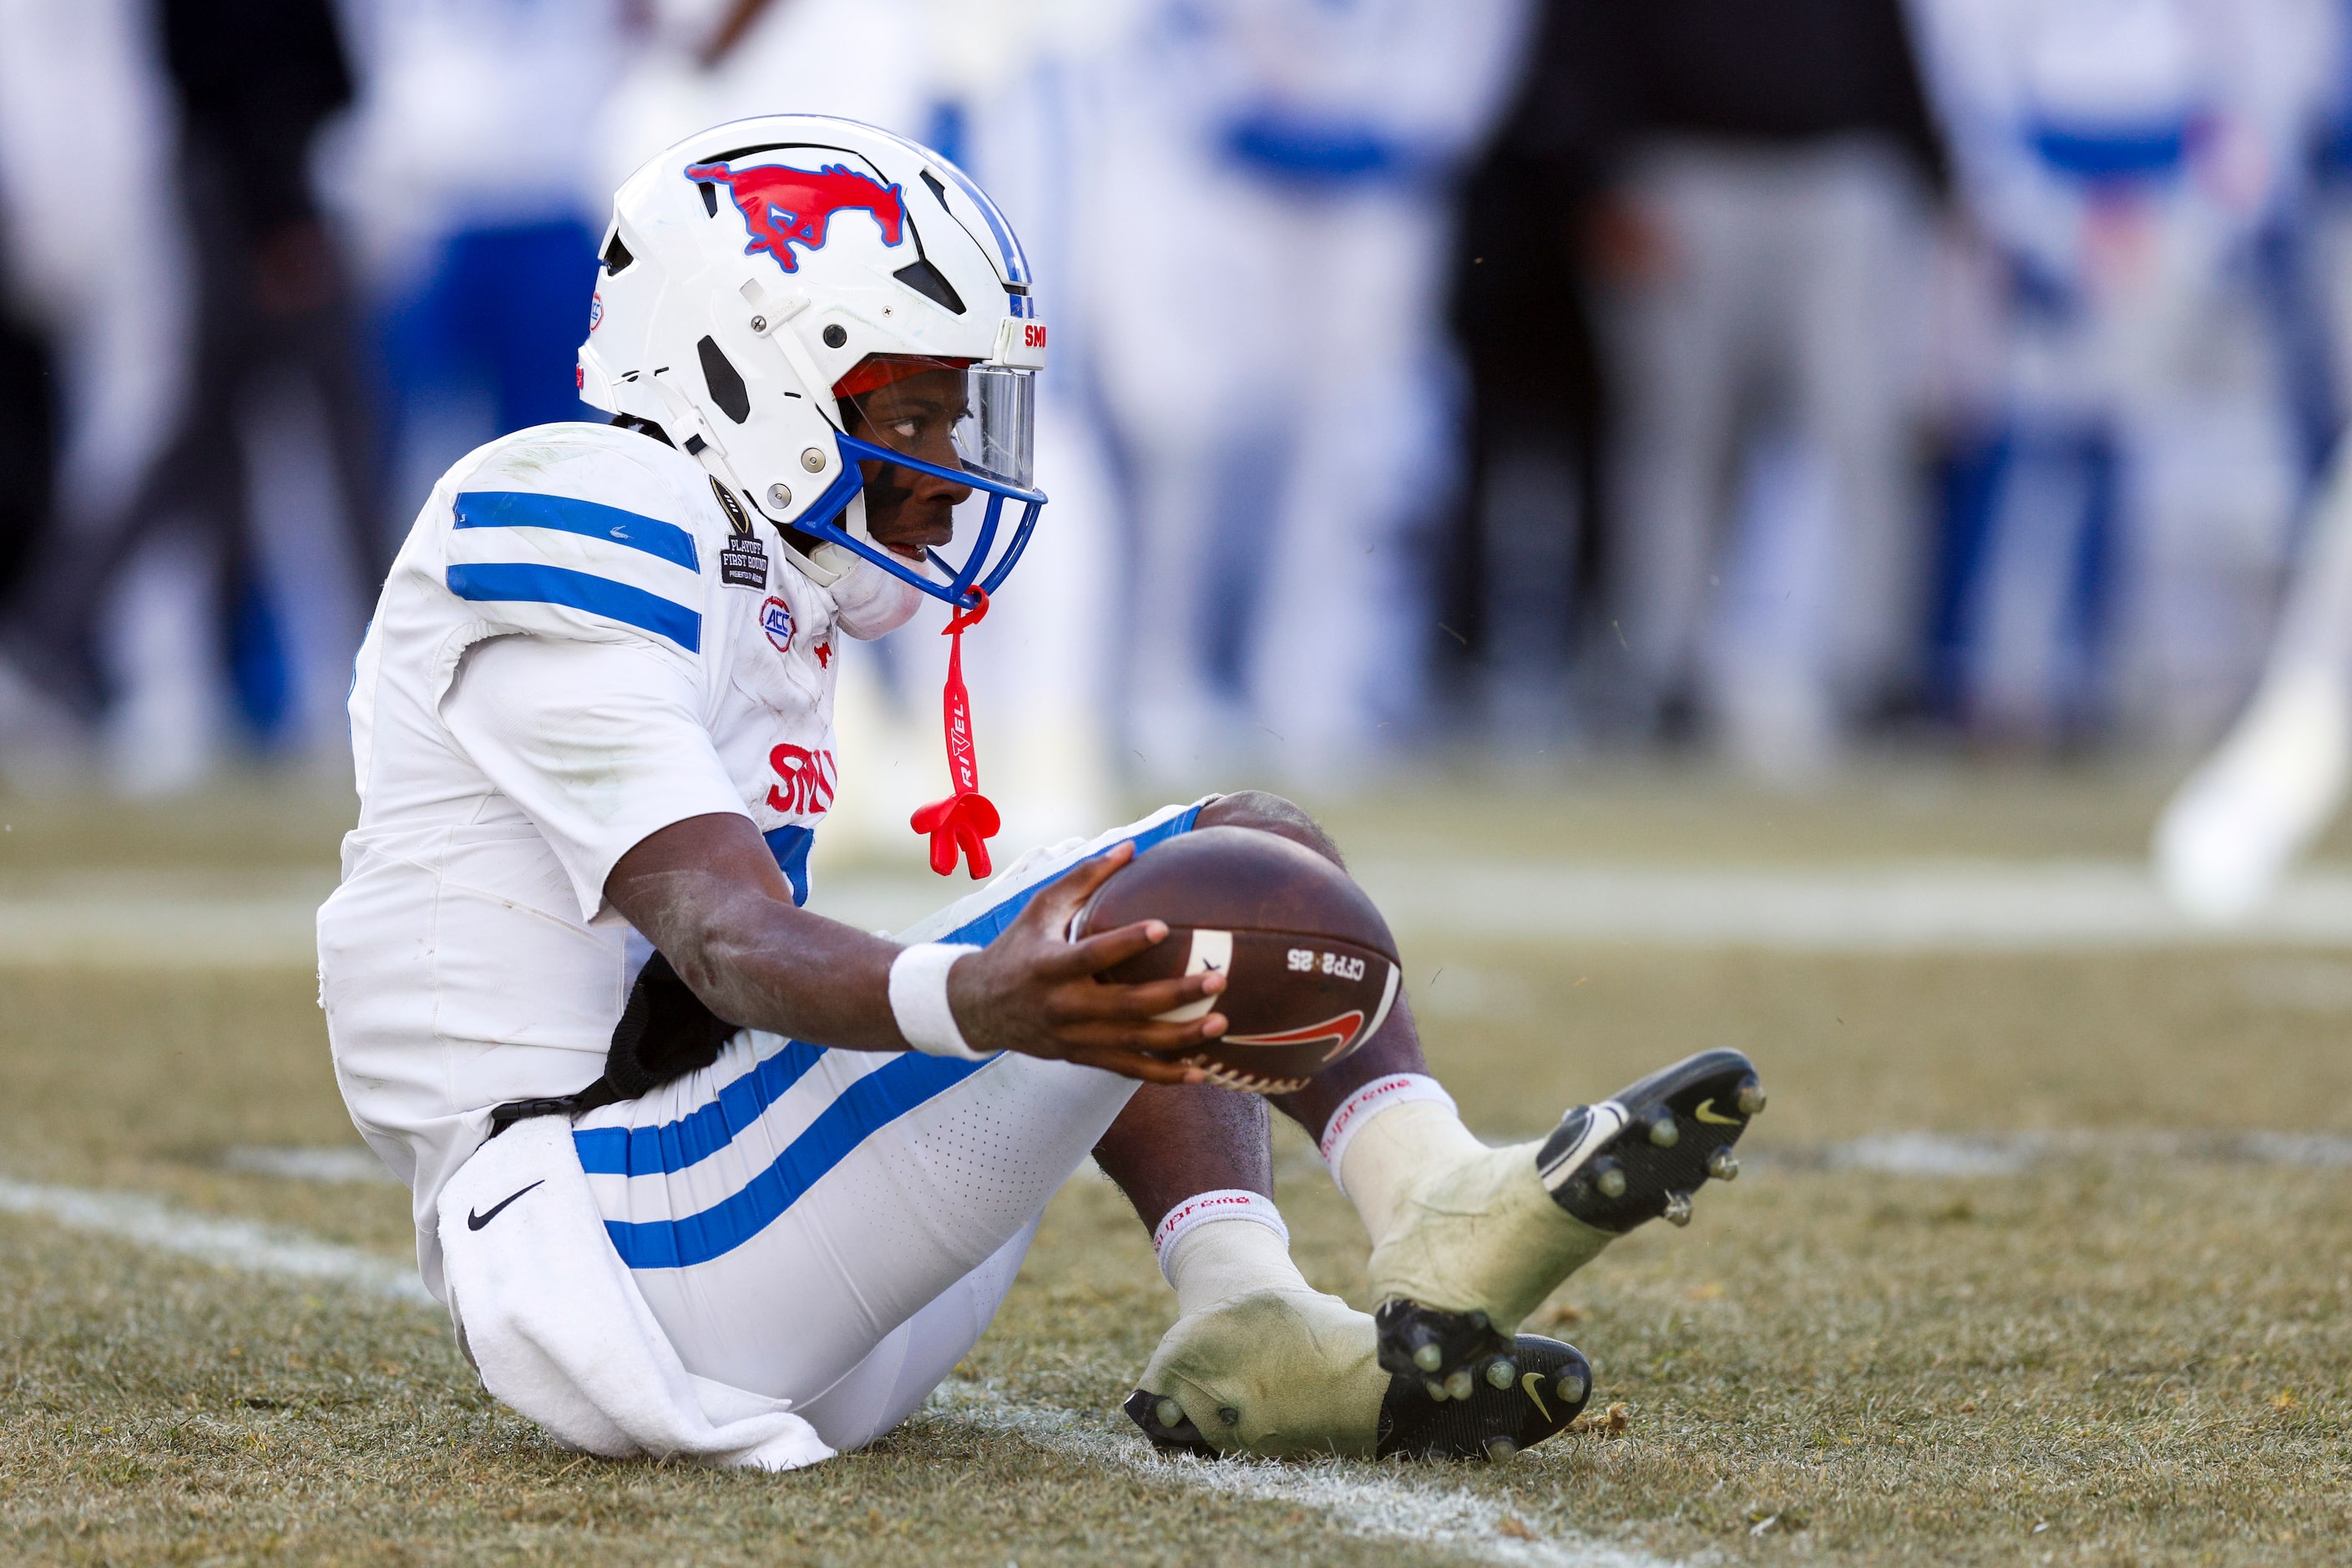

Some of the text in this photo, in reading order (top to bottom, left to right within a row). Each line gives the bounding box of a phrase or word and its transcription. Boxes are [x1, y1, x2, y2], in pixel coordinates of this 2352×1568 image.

[730, 539, 761, 554] PLAYOFF
[723, 554, 767, 572] FIRST ROUND
[766, 609, 790, 632] ACC
[951, 703, 973, 787] RIVEL
